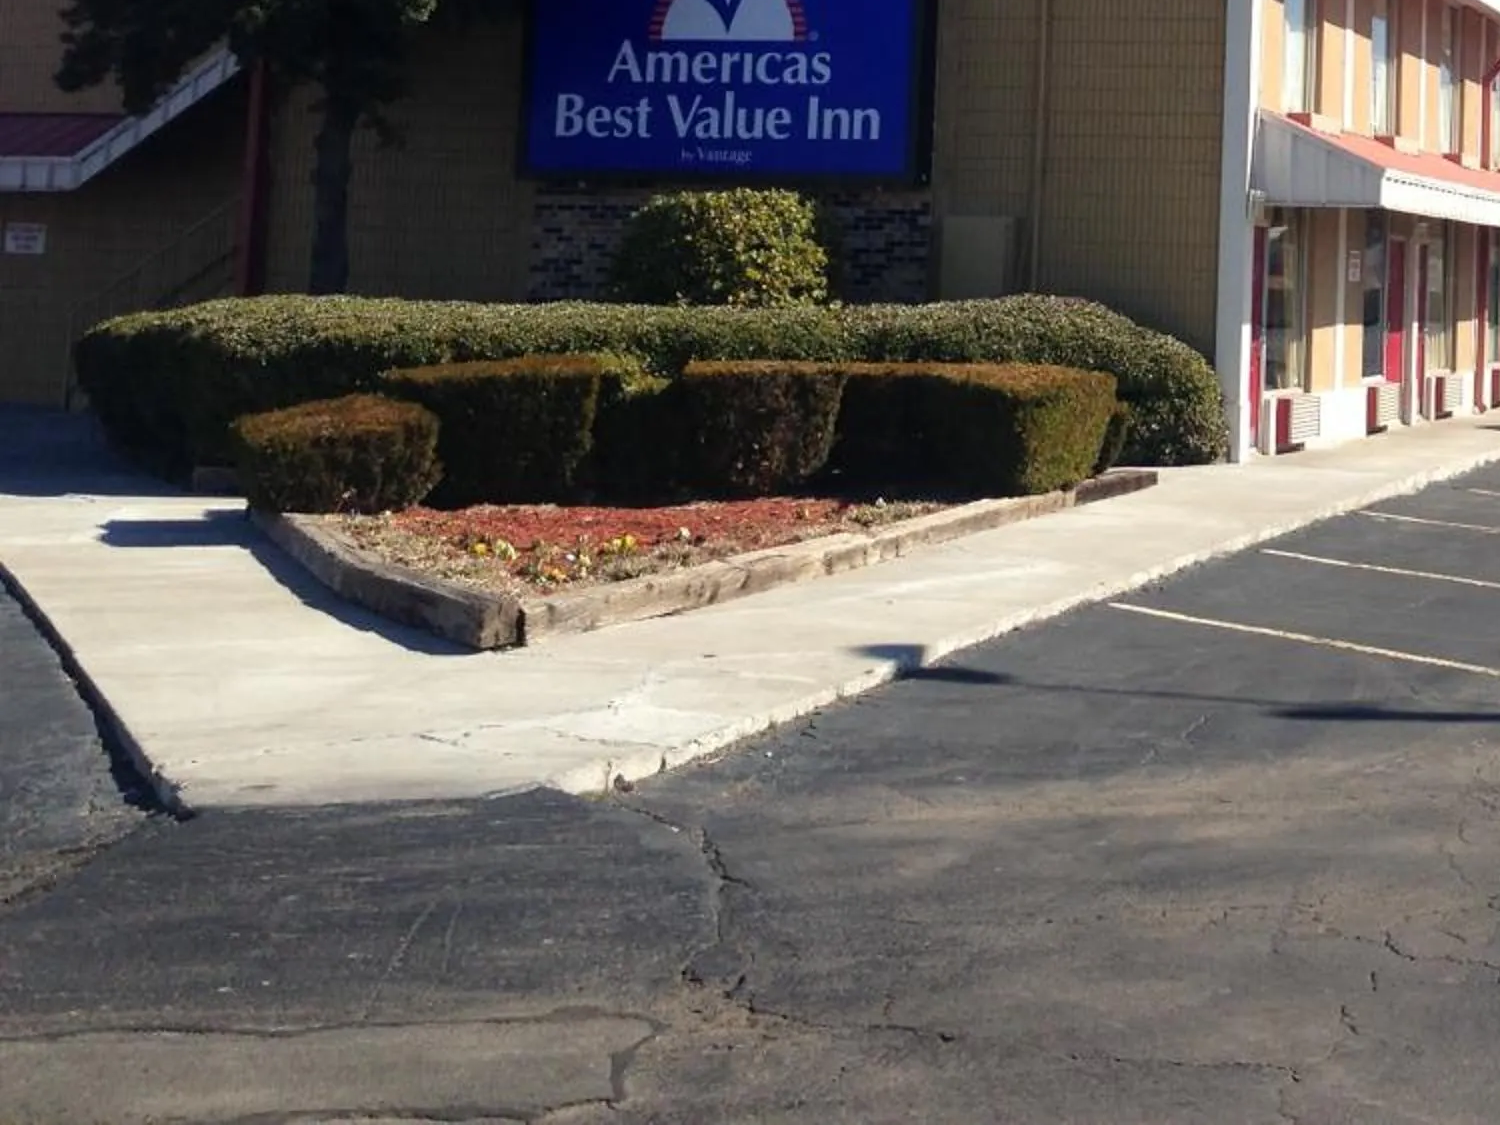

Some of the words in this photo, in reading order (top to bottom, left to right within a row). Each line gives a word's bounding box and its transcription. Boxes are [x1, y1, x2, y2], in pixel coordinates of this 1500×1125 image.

[607, 39, 832, 85] Americas
[554, 93, 651, 139] Best
[667, 90, 791, 140] Value
[807, 95, 881, 141] Inn
